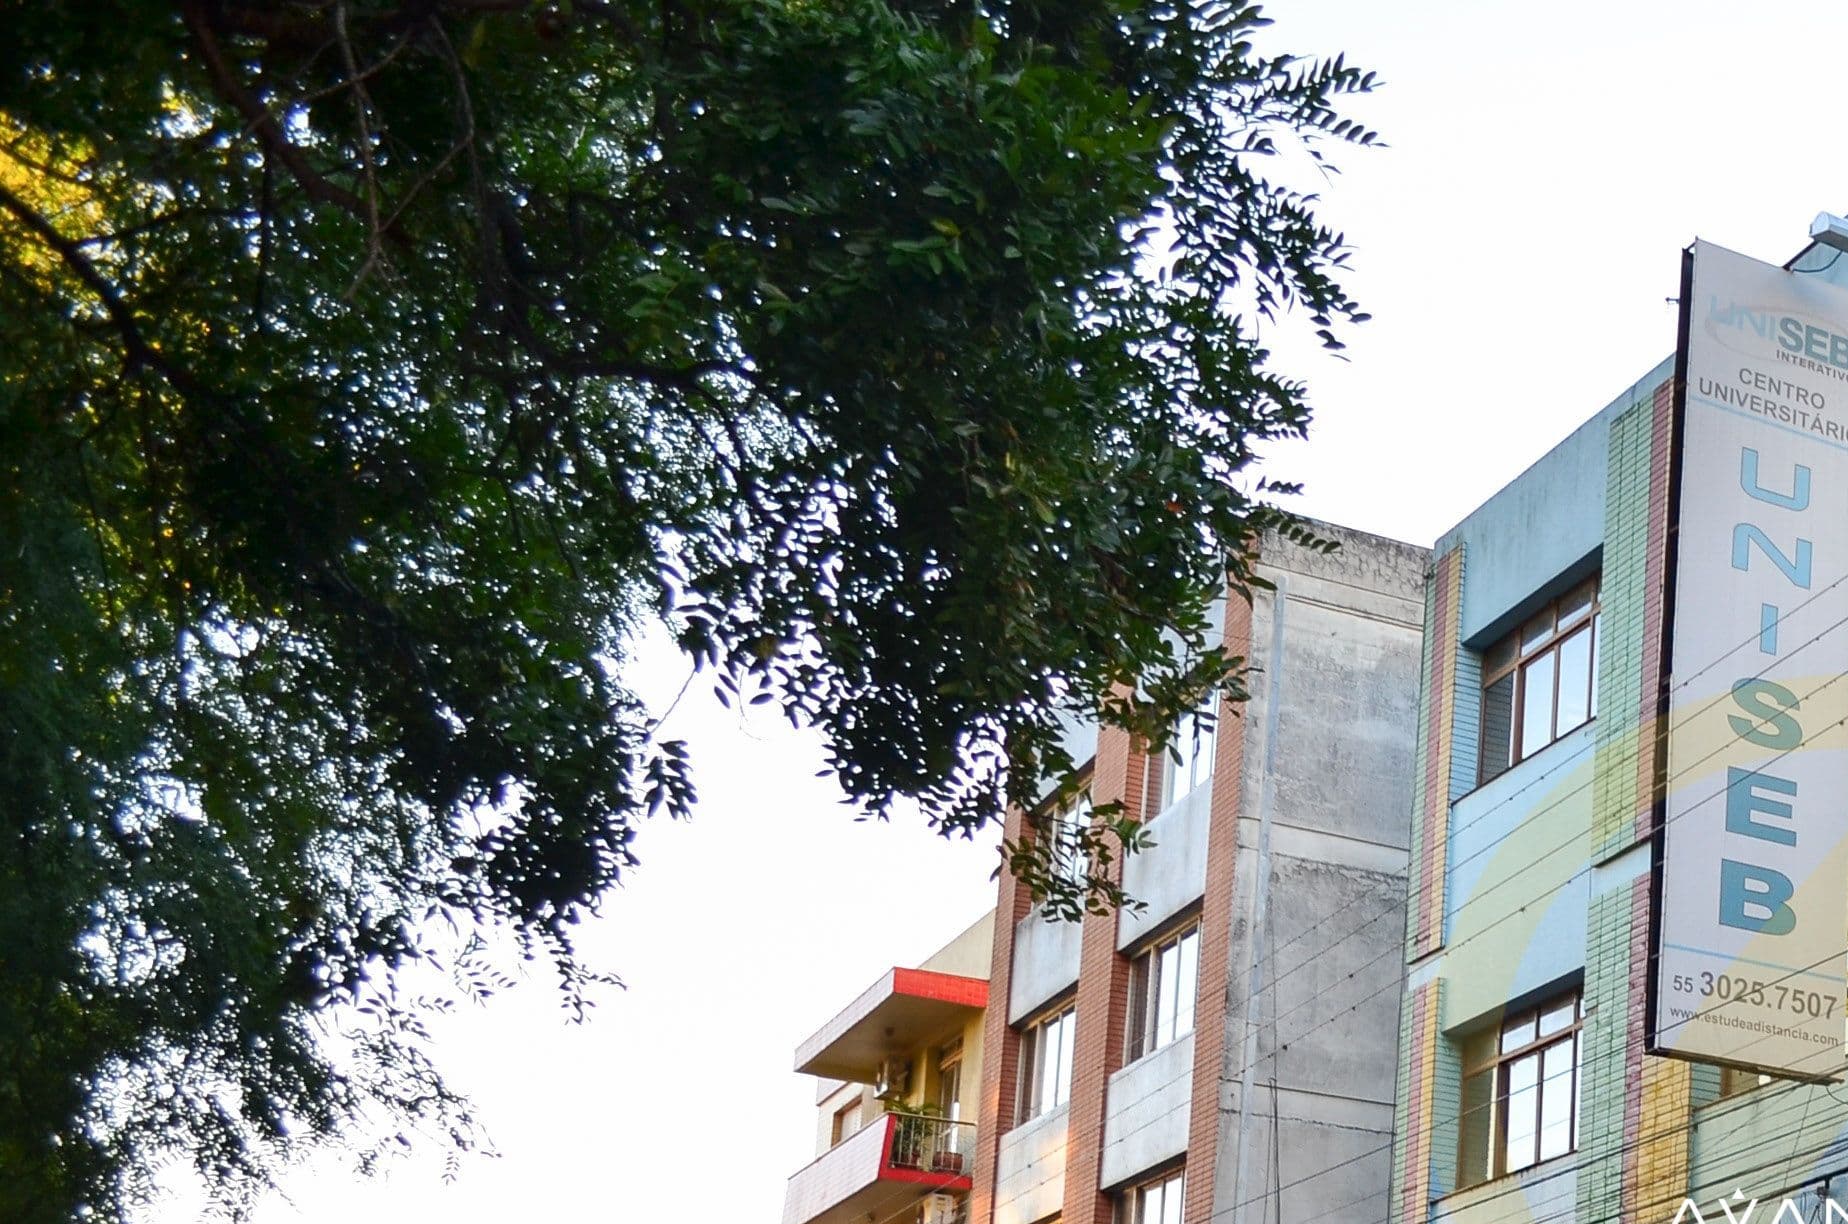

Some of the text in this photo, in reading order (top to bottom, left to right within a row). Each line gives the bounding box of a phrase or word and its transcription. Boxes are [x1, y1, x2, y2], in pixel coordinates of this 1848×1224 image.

[1739, 367, 1825, 410] CENTRO
[1673, 971, 1837, 1020] 55 3025.7507
[1669, 1006, 1840, 1047] www.estudeadistancia.com
